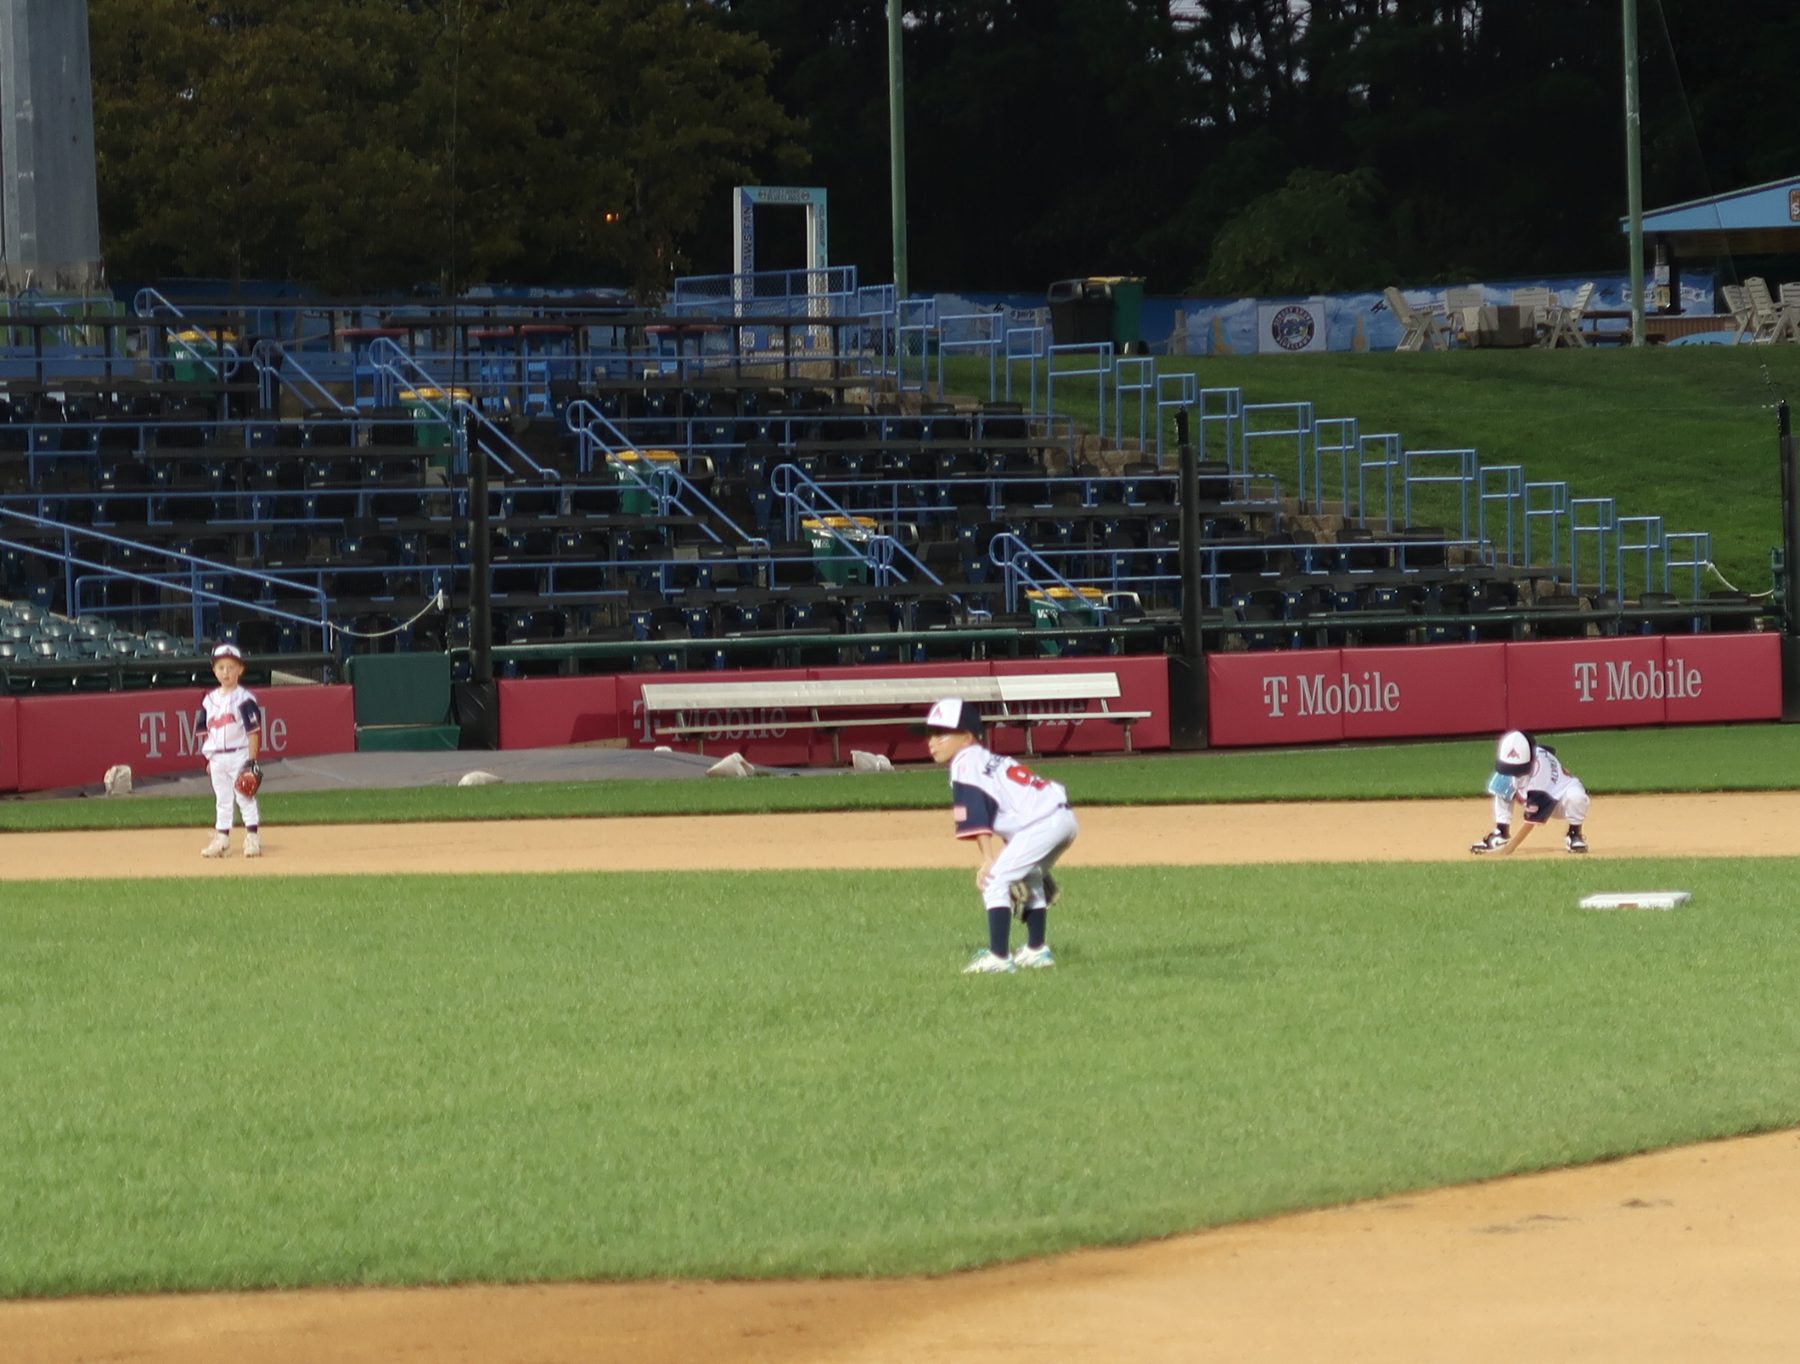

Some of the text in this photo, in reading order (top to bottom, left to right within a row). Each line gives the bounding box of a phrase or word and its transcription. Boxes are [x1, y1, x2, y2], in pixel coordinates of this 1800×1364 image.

[1263, 671, 1400, 717] T Mobile
[1574, 658, 1702, 702] T Mobile
[139, 711, 167, 758] T
